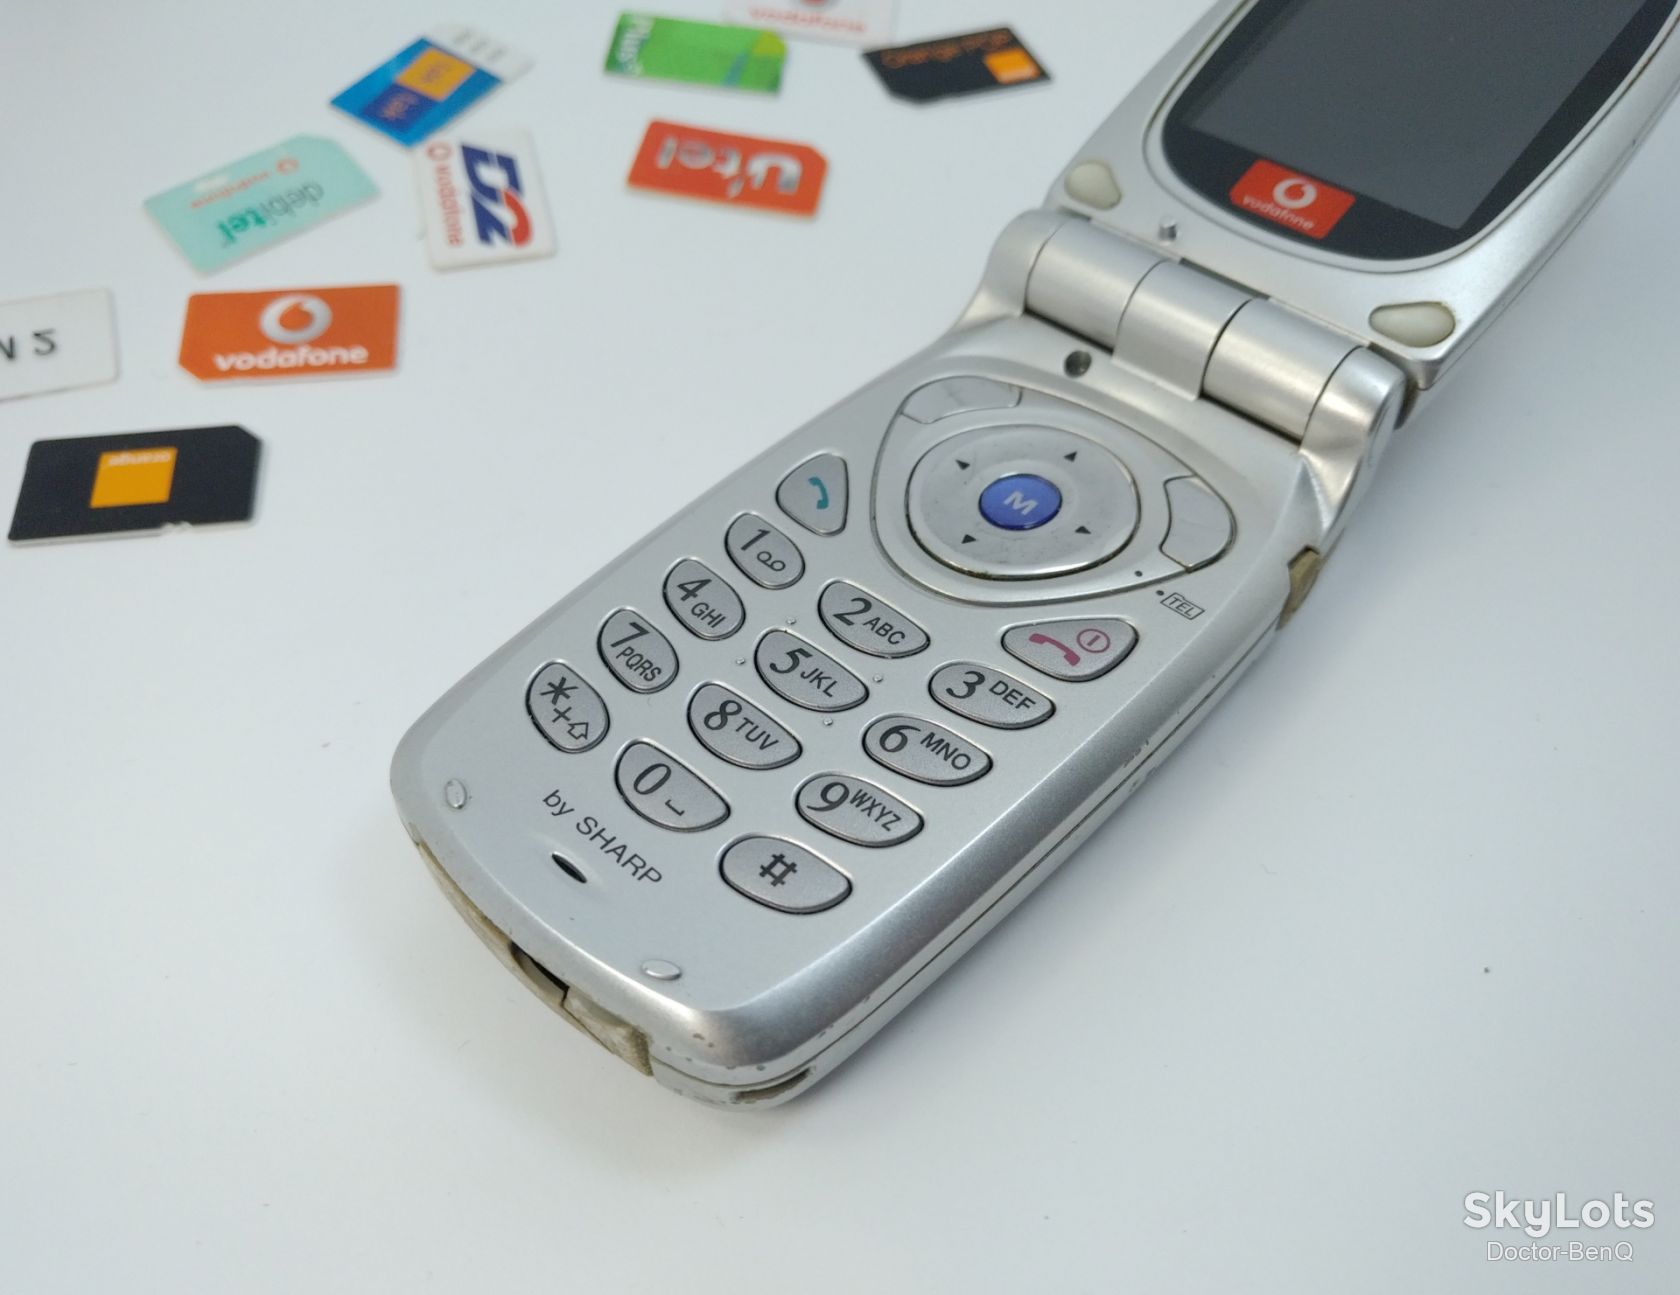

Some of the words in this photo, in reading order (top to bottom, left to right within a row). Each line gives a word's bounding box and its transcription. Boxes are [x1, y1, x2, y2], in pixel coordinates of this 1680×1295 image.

[461, 144, 533, 248] D2
[1242, 195, 1315, 230] vodafone
[212, 345, 370, 371] vodafone
[1004, 491, 1038, 515] M
[740, 528, 770, 551] 1
[677, 578, 712, 602] 4
[1168, 595, 1200, 618] TEL
[690, 602, 726, 629] GHI
[833, 597, 872, 626] 2
[863, 617, 906, 645] ABC
[610, 621, 650, 648] 7
[616, 646, 662, 682] PQRS
[769, 648, 813, 674] 5
[801, 667, 839, 698] JKL
[946, 671, 985, 699] 3
[988, 680, 1036, 710] DEF
[704, 699, 742, 731] 8
[735, 717, 779, 750] TUV
[879, 725, 921, 752] 6
[920, 732, 971, 770] MNO
[633, 763, 672, 795] 0
[807, 781, 850, 811] 9
[850, 789, 901, 831] WXYZ
[542, 790, 575, 817] by
[576, 816, 663, 885] SHARP
[759, 854, 797, 887] #
